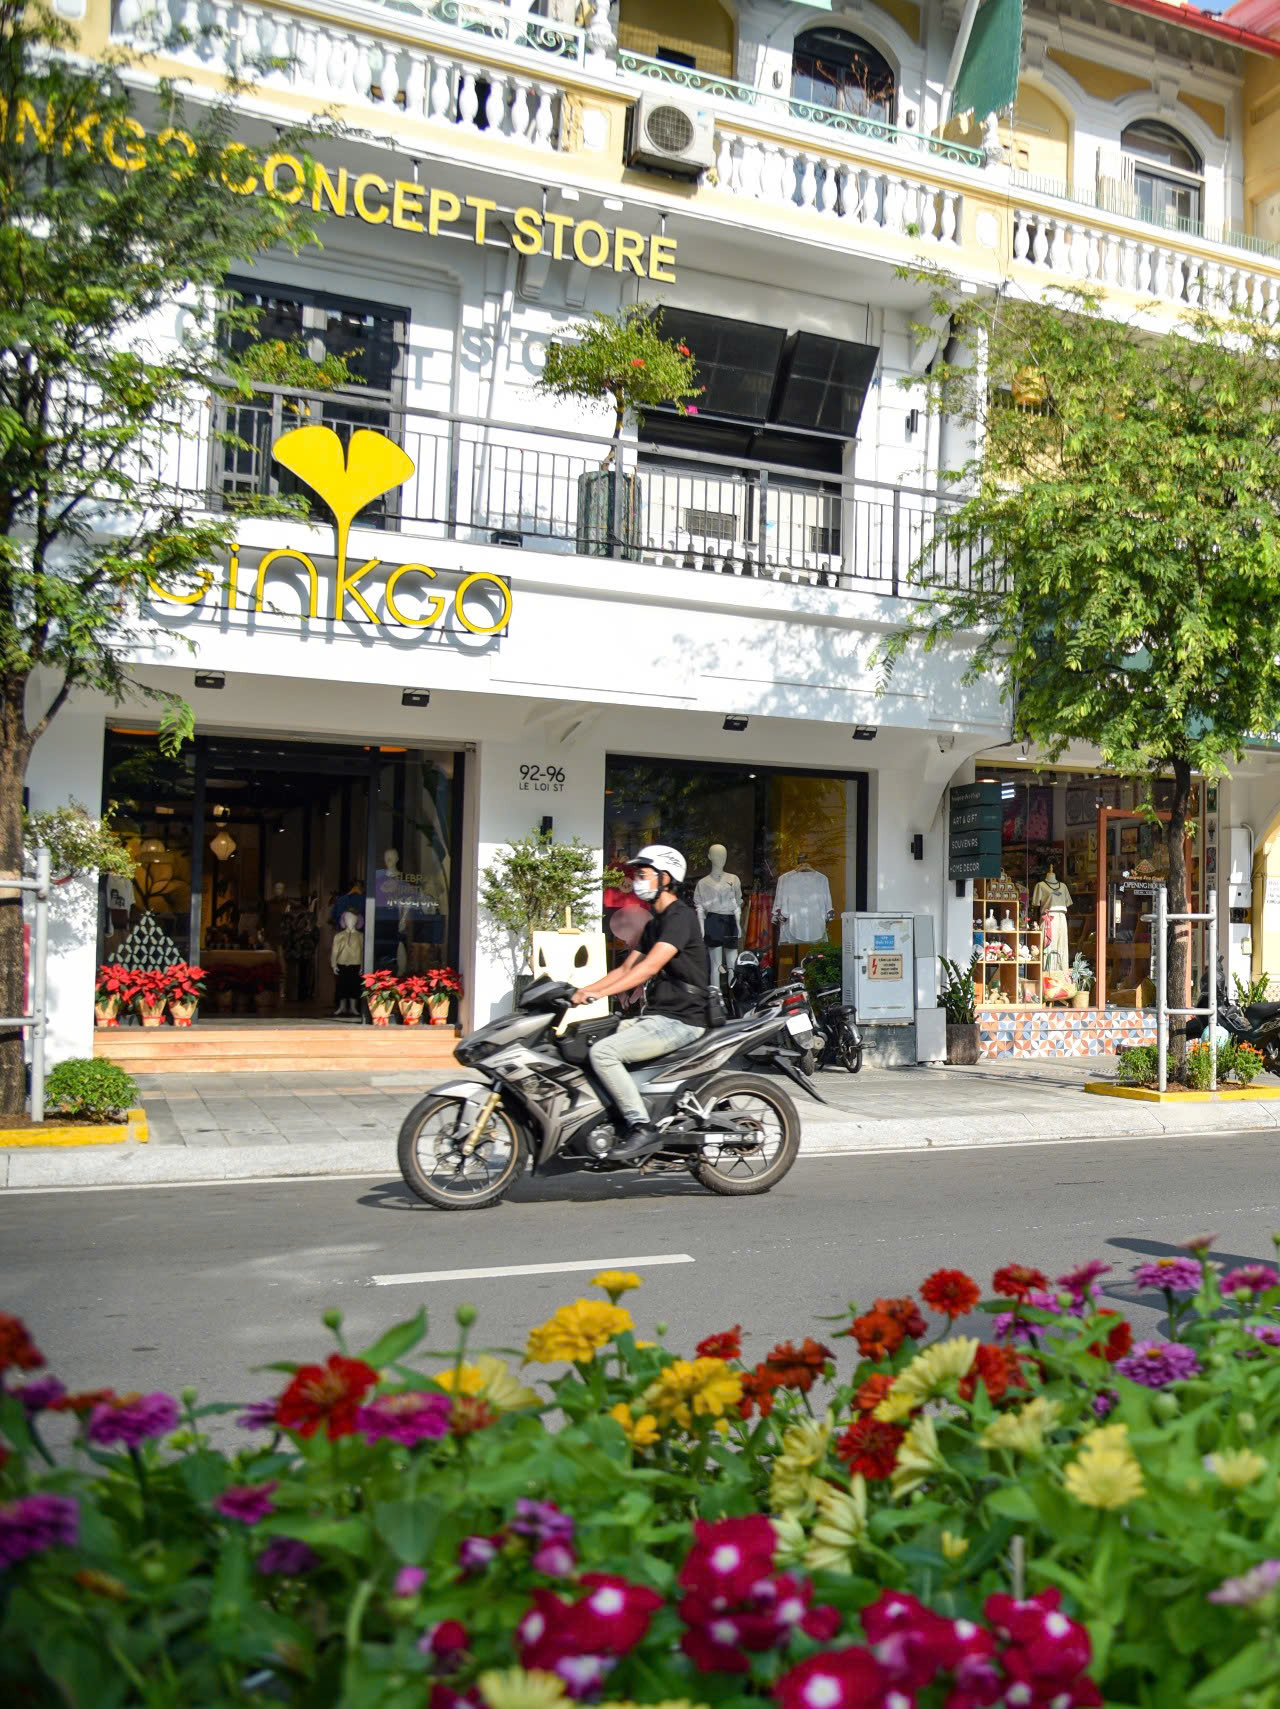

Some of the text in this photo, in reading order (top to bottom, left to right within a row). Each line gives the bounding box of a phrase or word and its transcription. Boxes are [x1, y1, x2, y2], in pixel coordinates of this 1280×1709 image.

[217, 142, 497, 246] CONCEPT
[511, 206, 678, 284] STORE
[519, 764, 566, 783] 92-96
[519, 782, 564, 792] LE LOI ST
[1123, 881, 1148, 889] OPENING
